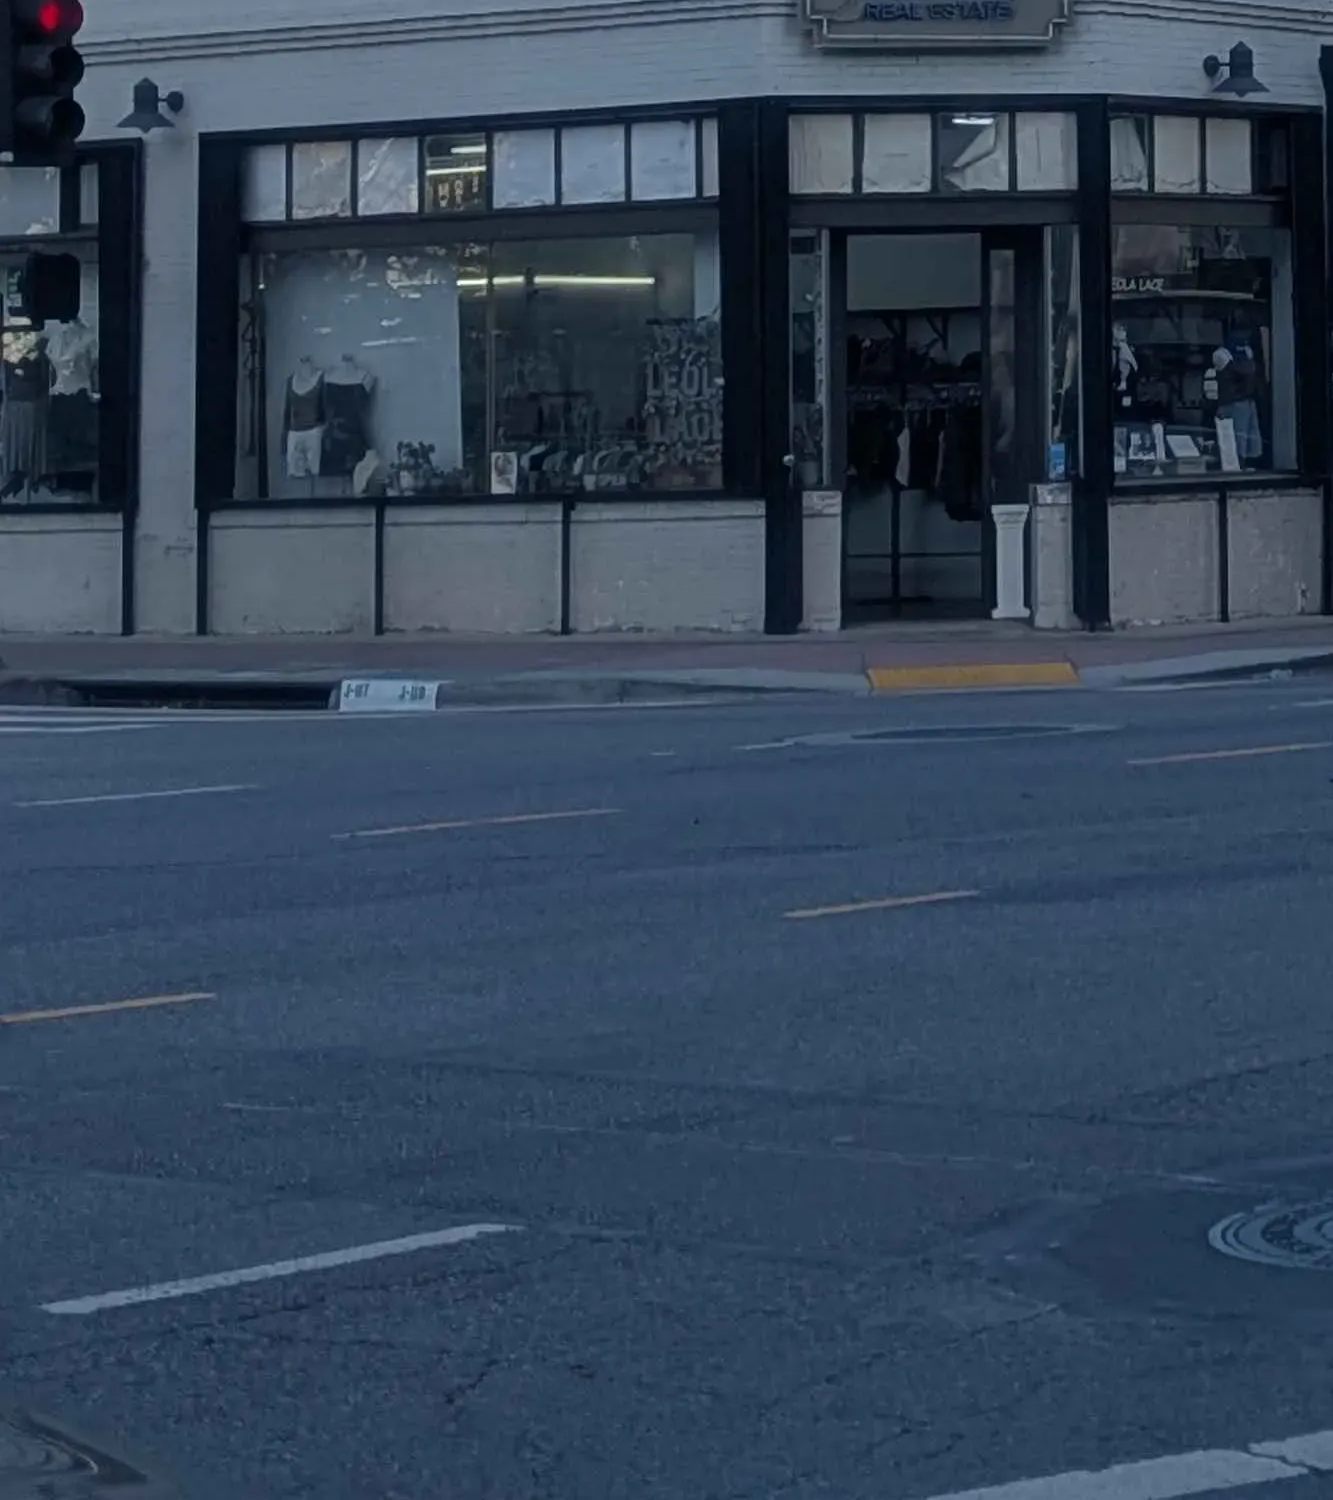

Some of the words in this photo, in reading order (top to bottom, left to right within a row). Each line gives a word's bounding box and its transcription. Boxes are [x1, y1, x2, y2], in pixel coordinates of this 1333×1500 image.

[864, 3, 923, 21] REAL
[928, 3, 1014, 21] ESTATE
[1112, 276, 1136, 291] EOLA
[647, 363, 717, 397] LEOL
